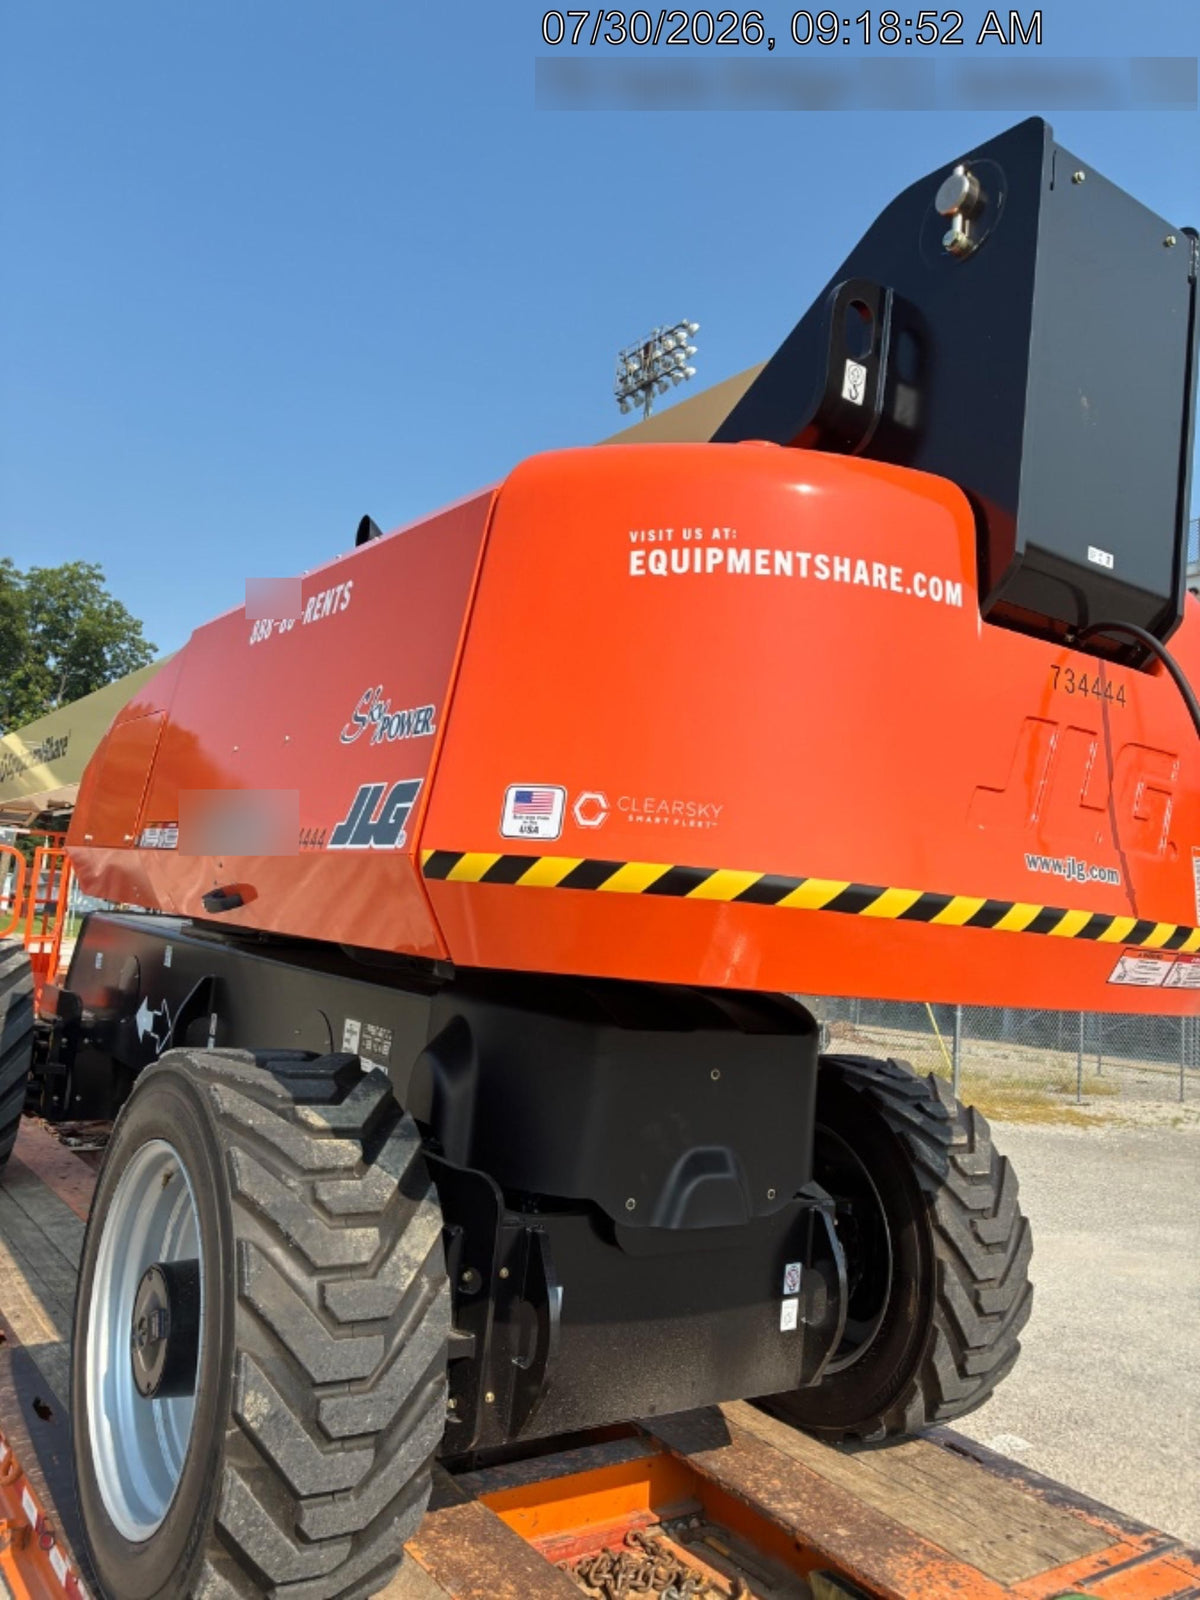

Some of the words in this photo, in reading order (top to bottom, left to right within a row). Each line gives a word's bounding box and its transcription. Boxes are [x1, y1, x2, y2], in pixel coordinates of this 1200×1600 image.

[629, 529, 674, 543] VISIT
[682, 527, 703, 540] US
[711, 527, 737, 541] AT:
[629, 547, 963, 608] EQUIPMENTSHARE.COM
[1050, 664, 1126, 708] 734444
[617, 796, 724, 818] CLEARSKY
[628, 813, 669, 825] SMART
[1023, 853, 1120, 886] www.jlg.com
